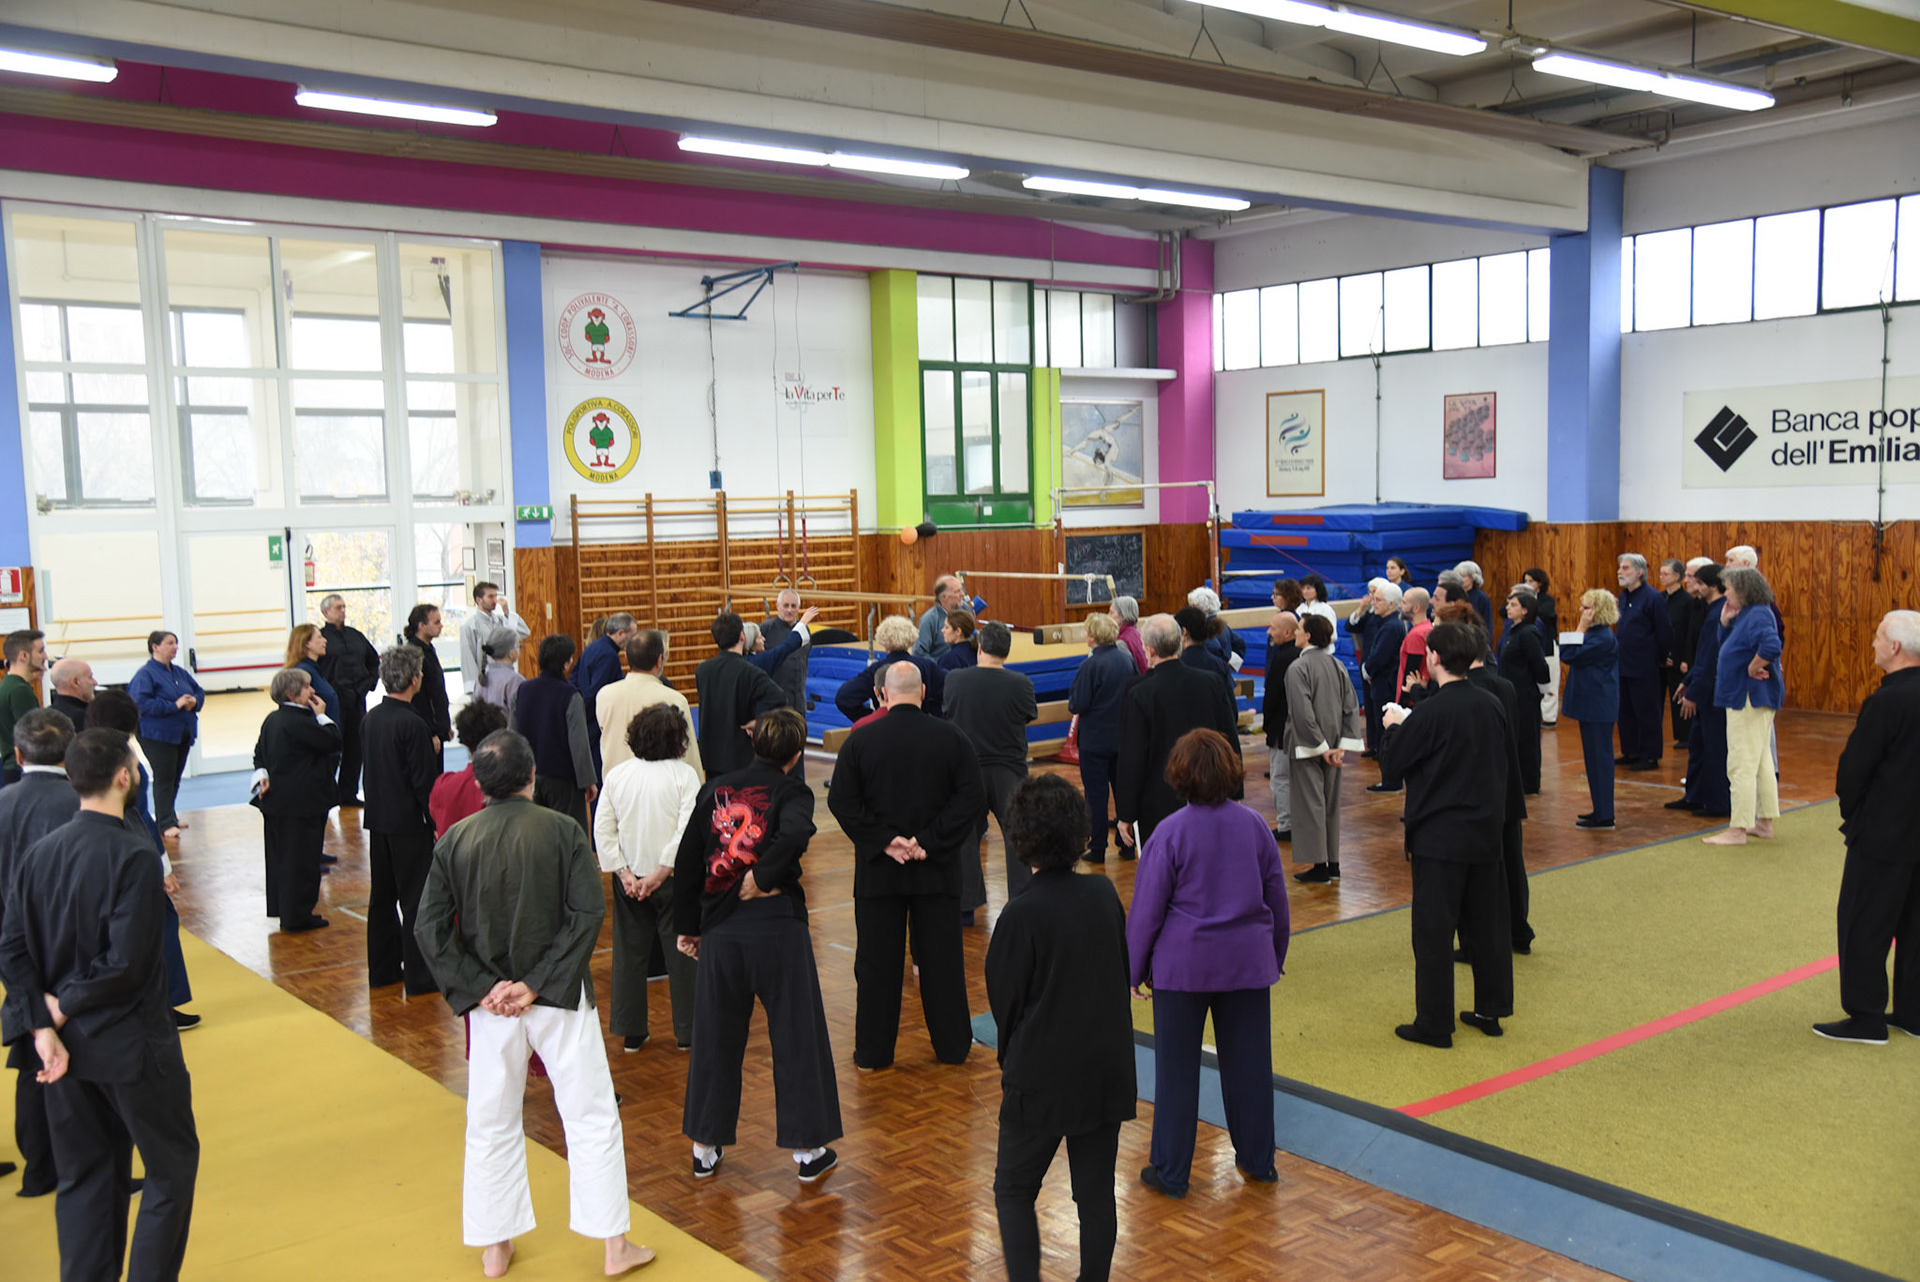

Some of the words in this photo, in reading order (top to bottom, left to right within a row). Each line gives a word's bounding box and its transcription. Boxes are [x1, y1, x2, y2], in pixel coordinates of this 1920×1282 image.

[567, 295, 608, 315] POLIVALENTE
[585, 368, 614, 378] MODENA
[567, 400, 603, 435] POLISPORTIVA
[1772, 409, 1859, 433] Banca
[1772, 437, 1920, 466] dell'Emilia
[589, 472, 618, 482] MODENA
